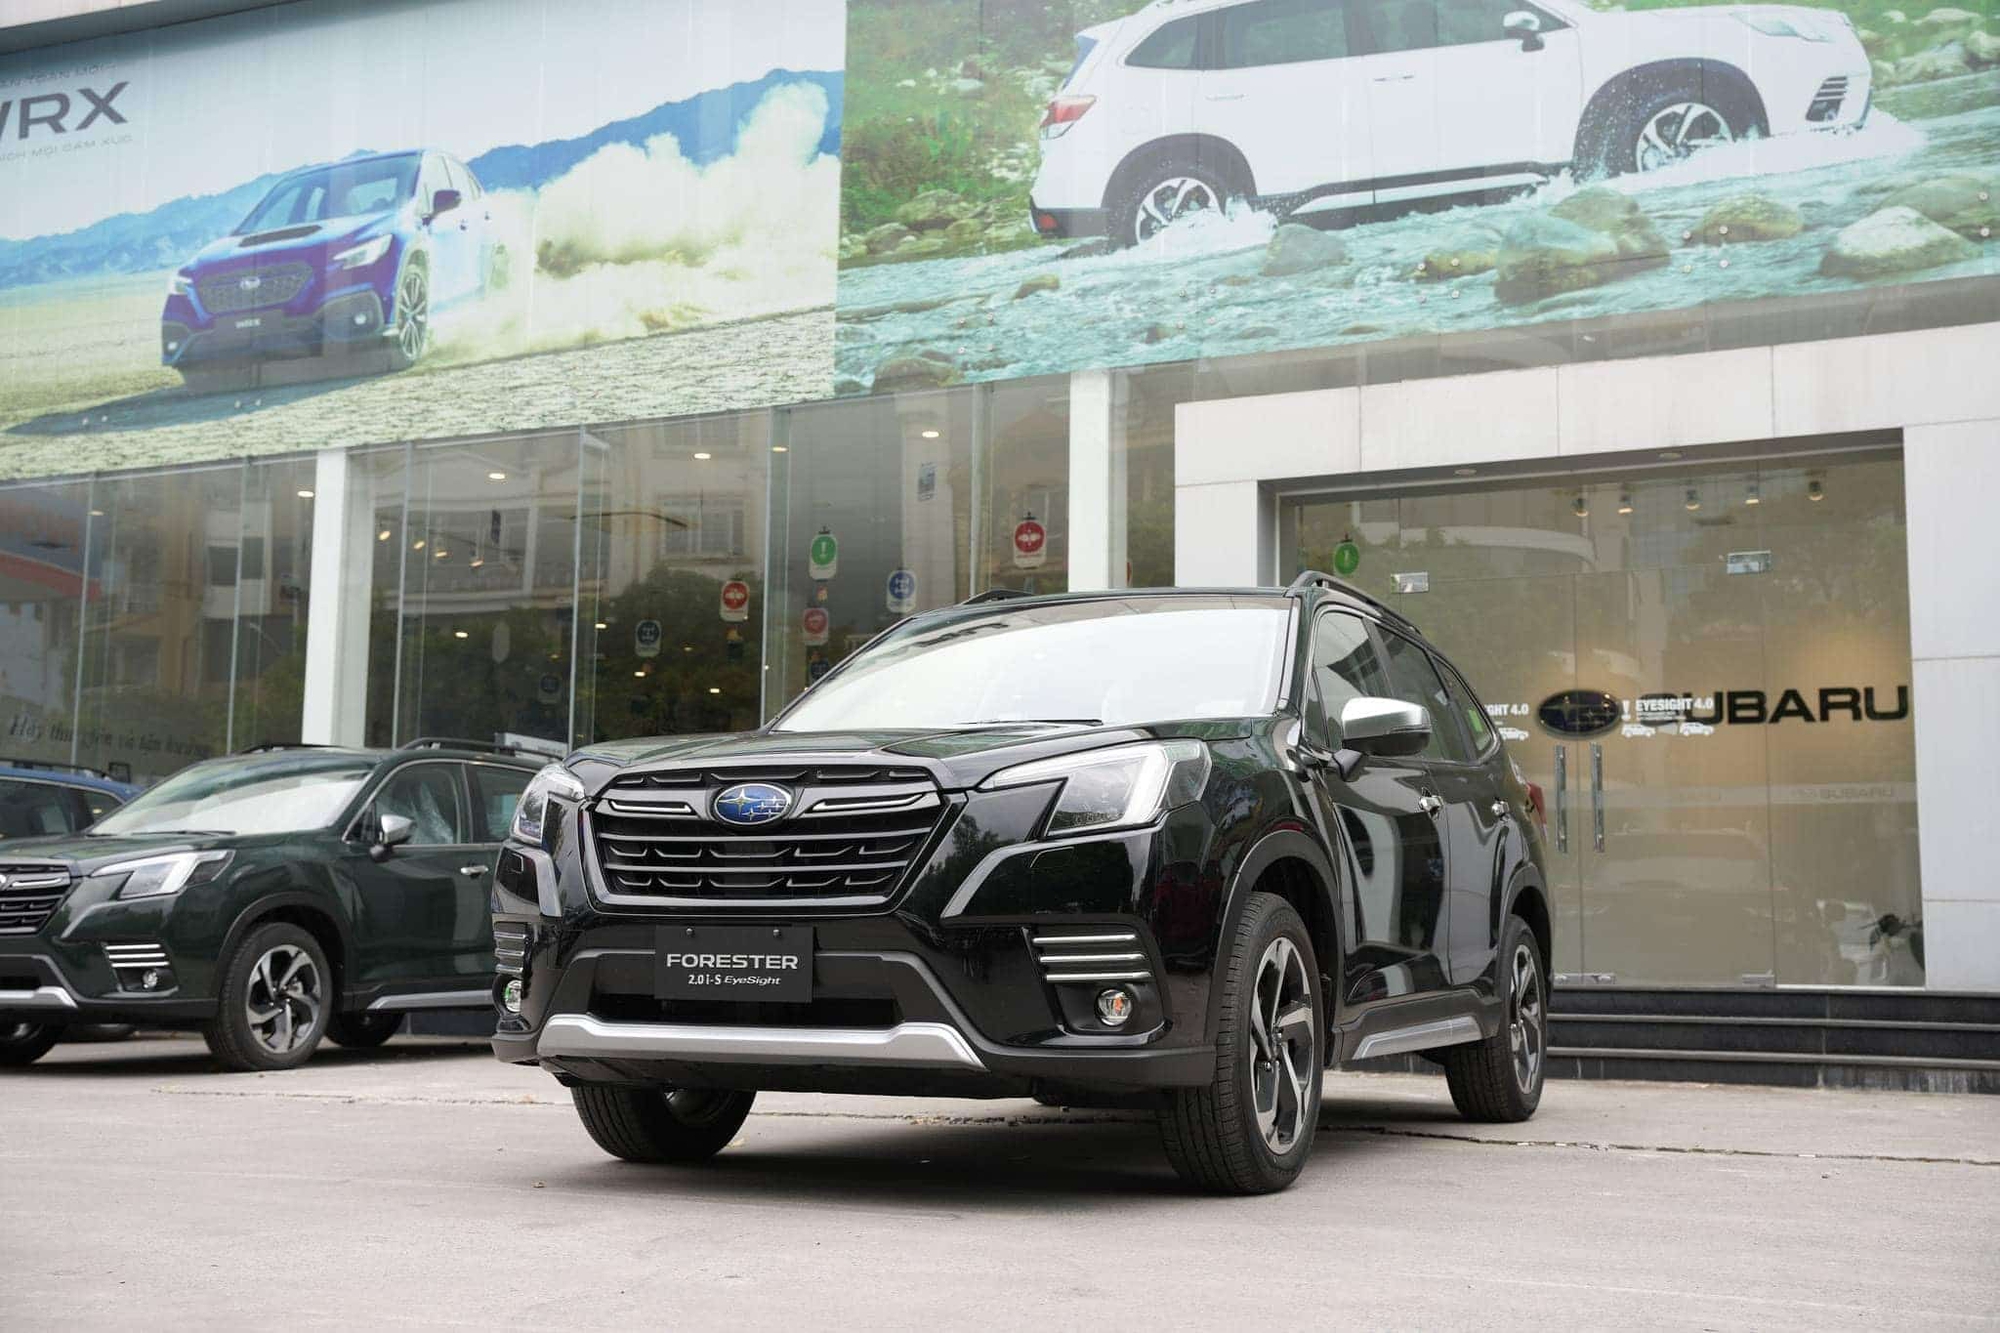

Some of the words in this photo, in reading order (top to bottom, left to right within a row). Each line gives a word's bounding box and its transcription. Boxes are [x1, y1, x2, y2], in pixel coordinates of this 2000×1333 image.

[0, 81, 130, 140] RX
[1510, 702, 1529, 715] 4.0
[1635, 697, 1693, 712] EYESIGHT
[1694, 697, 1714, 709] 4.0
[666, 953, 799, 970] FORESTER
[724, 975, 781, 986] EyeSight
